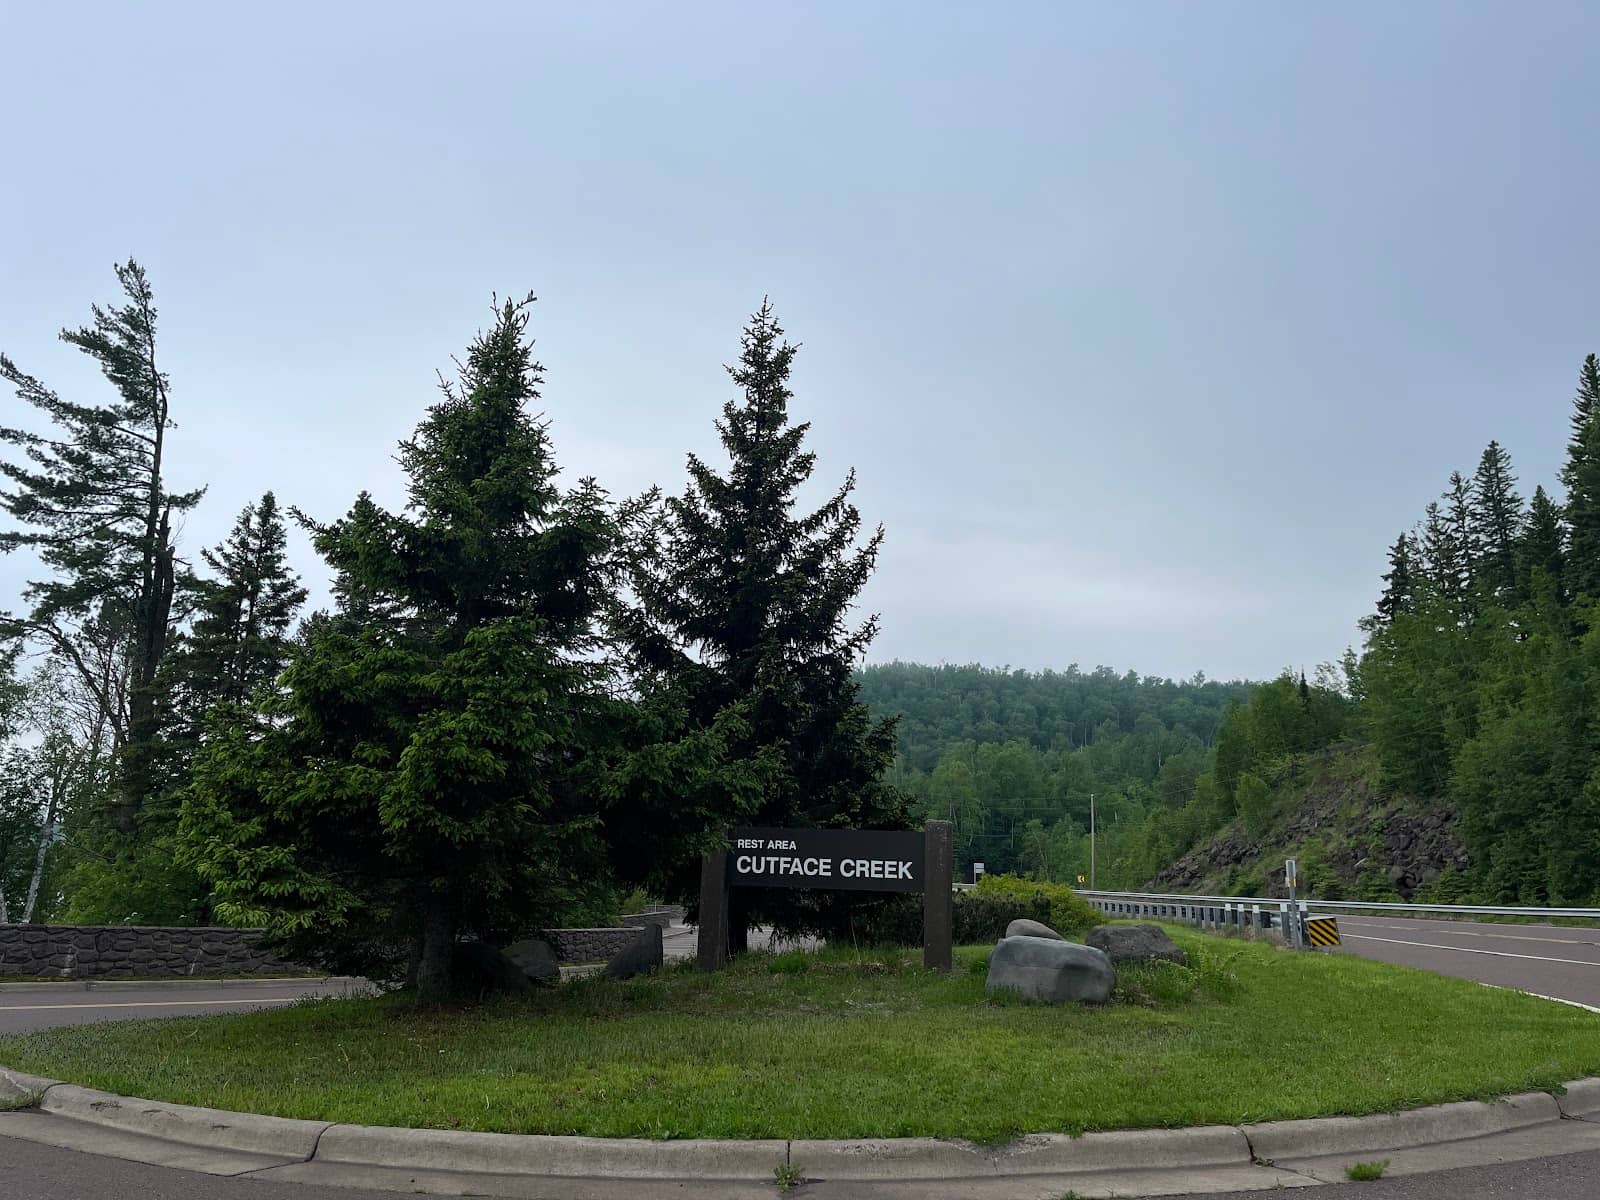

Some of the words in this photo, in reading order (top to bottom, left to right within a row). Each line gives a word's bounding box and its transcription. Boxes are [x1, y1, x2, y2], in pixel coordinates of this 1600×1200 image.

[737, 839, 764, 849] REST
[767, 840, 797, 850] AREA
[736, 855, 832, 876] CUTFACE
[839, 859, 914, 880] CREEK
